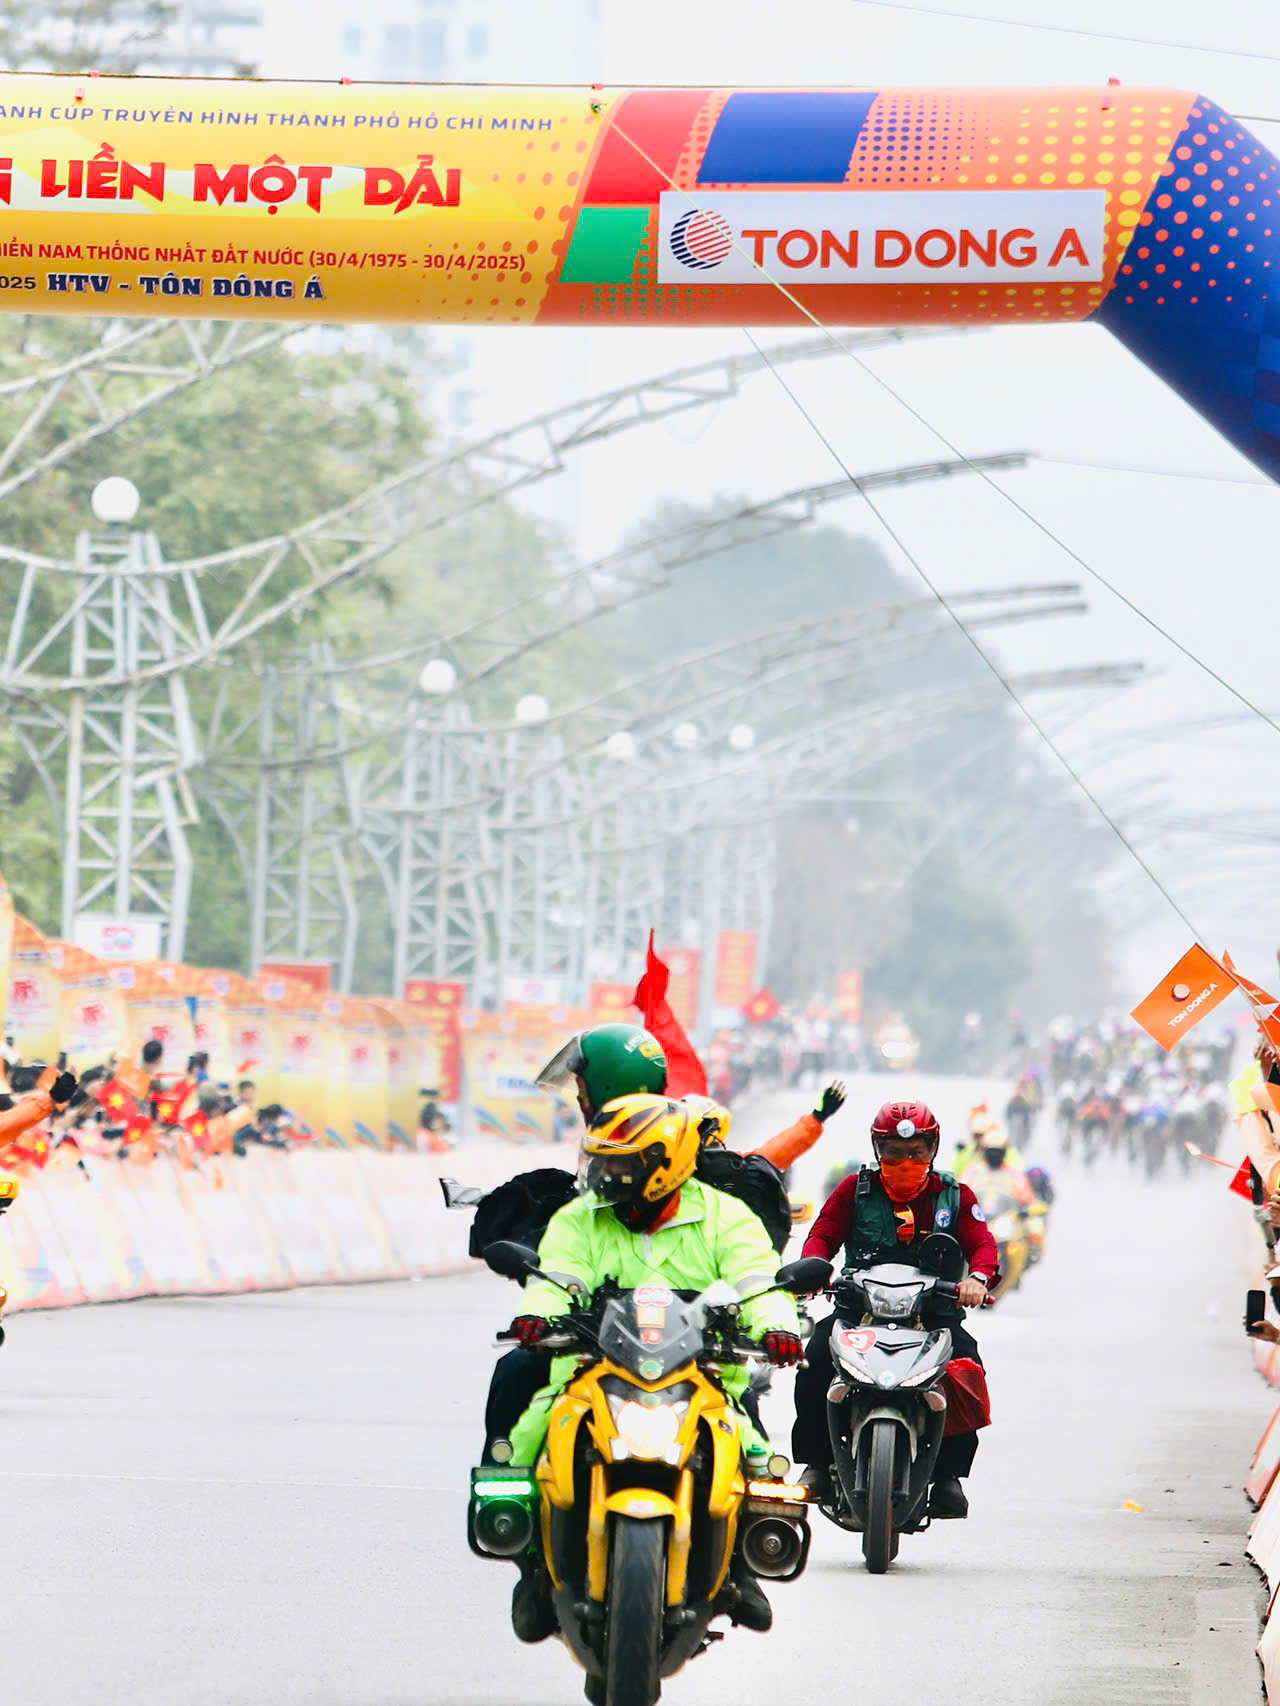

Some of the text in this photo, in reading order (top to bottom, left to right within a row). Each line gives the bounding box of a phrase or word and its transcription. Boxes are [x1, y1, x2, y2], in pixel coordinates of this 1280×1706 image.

[50, 104, 94, 121] CÚP
[101, 106, 193, 124] TRUYỀN
[201, 109, 259, 126] HÌNH
[266, 112, 346, 128] THÀNH
[353, 111, 401, 129] PHỐ
[407, 112, 439, 129] HỒ
[446, 114, 483, 130] CHÍ
[490, 117, 553, 131] MINH
[41, 142, 166, 203] LIỀN
[193, 153, 333, 215] MỘT
[364, 154, 462, 215] DẢI
[86, 238, 150, 261] THỐNG
[155, 241, 207, 263] NHẤT
[211, 242, 249, 264] ĐẤT
[253, 246, 305, 266] NƯỚC
[309, 250, 407, 268] (30/4/1975
[423, 253, 526, 272] 30/4/2025)
[741, 228, 1090, 269] TON DONG A
[48, 274, 110, 292] HTV
[139, 272, 202, 297] TÔN
[212, 274, 294, 299] ĐÔNG
[304, 275, 325, 299] Á
[1168, 983, 1218, 1027] TON DONG A
